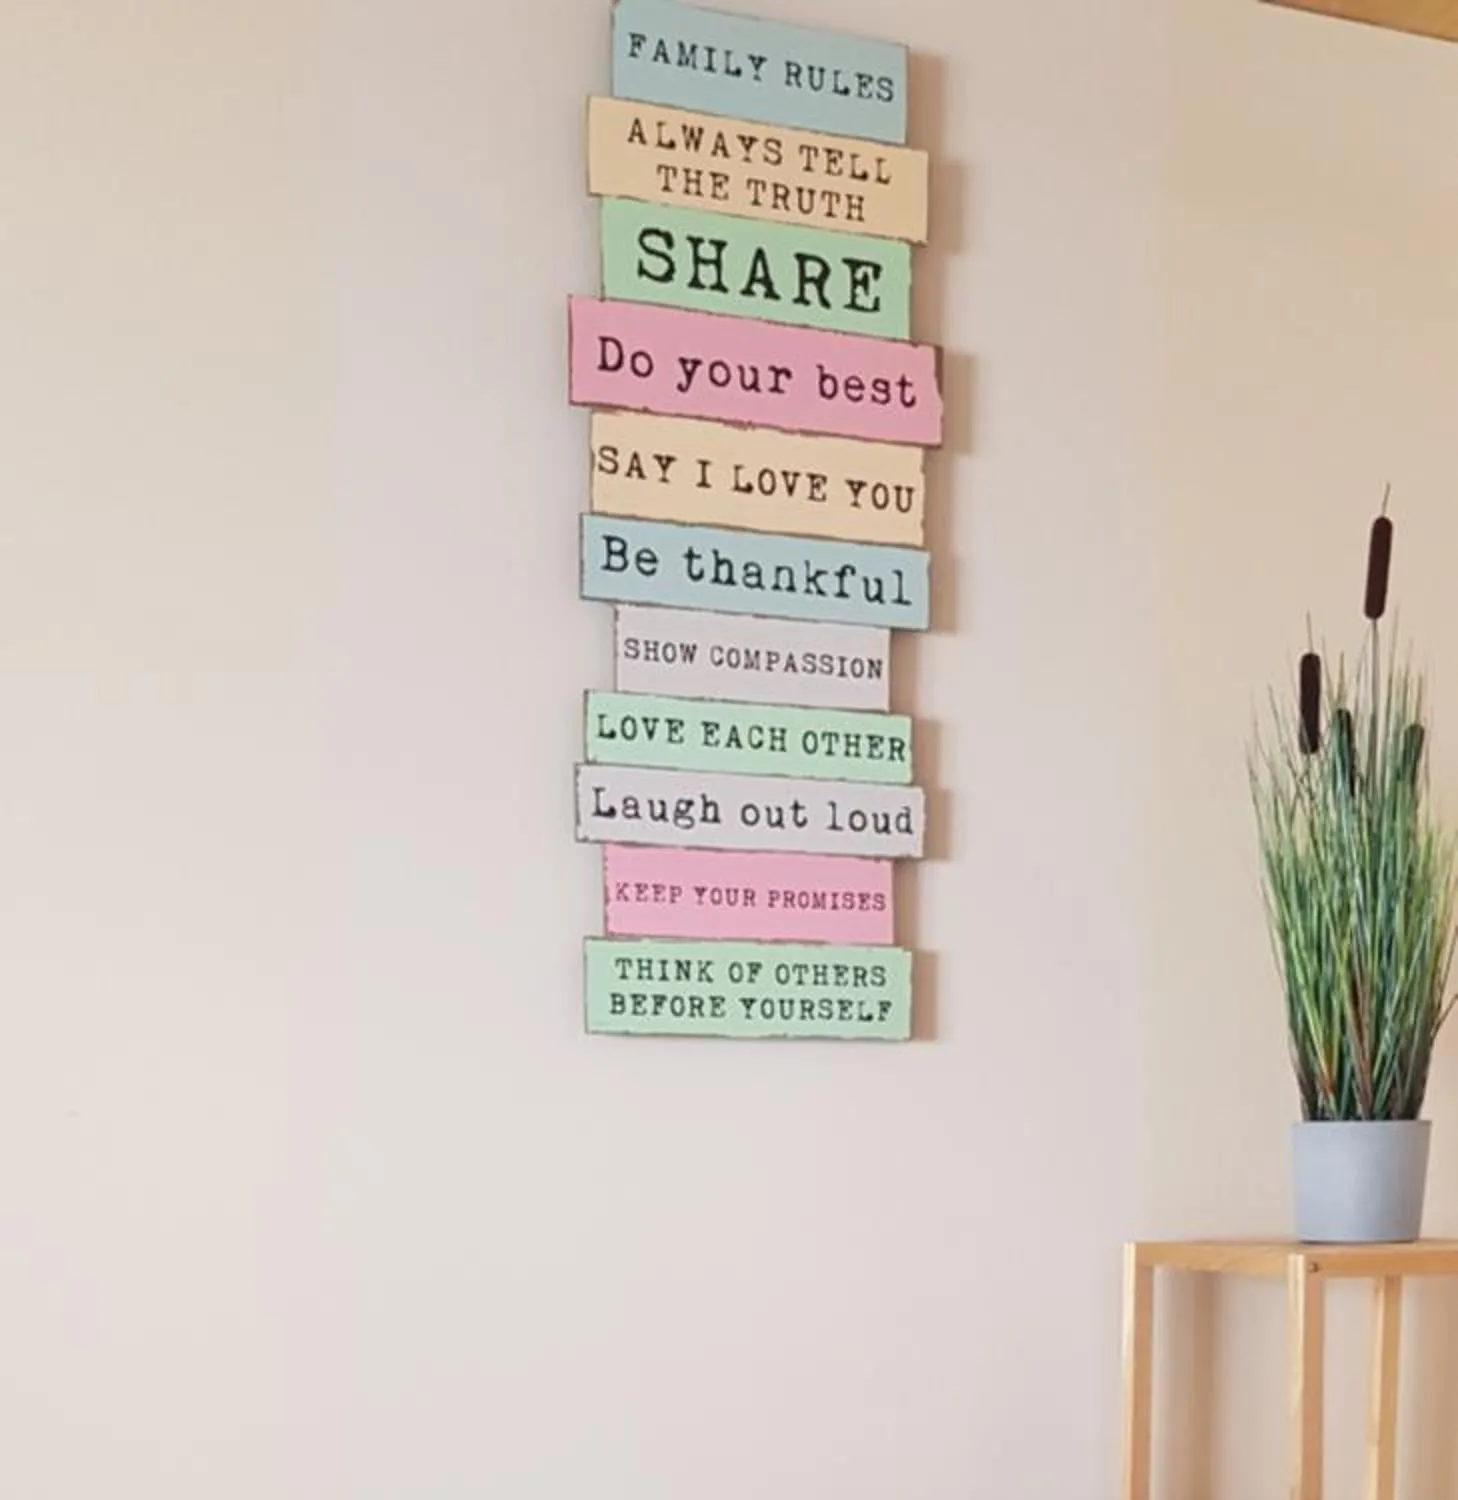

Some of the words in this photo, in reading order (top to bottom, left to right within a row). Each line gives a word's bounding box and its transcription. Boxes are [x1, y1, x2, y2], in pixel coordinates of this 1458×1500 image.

[628, 32, 768, 82] FAMILY
[785, 61, 894, 102] RULES
[627, 118, 782, 165] ALWAYS
[799, 144, 892, 185] TELL
[656, 164, 729, 201] THE
[746, 178, 865, 222] TRUTH
[637, 228, 882, 312] SHARE
[597, 336, 654, 378] Do
[677, 357, 793, 394] your
[816, 365, 916, 408] best
[598, 446, 677, 482] SAY
[697, 459, 712, 488] I
[733, 464, 828, 502] LOVE
[845, 479, 915, 514] YOU
[601, 535, 659, 576] Be
[683, 546, 913, 606] thankful
[623, 638, 697, 665] SHOW
[710, 645, 883, 680] COMPASSION
[596, 713, 685, 744] LOVE
[700, 721, 788, 752] EACH
[802, 730, 906, 762] OTHER
[591, 786, 721, 829] Laugh
[740, 801, 809, 827] out
[828, 801, 913, 835] loud
[615, 881, 682, 904] KEEP
[694, 885, 756, 907] YOUR
[767, 889, 887, 911] PROMISES
[614, 957, 714, 984] THINK
[728, 961, 763, 984] OF
[775, 963, 887, 987] OTHERS
[609, 993, 726, 1018] BEFORE
[741, 998, 893, 1022] YOURSELF
